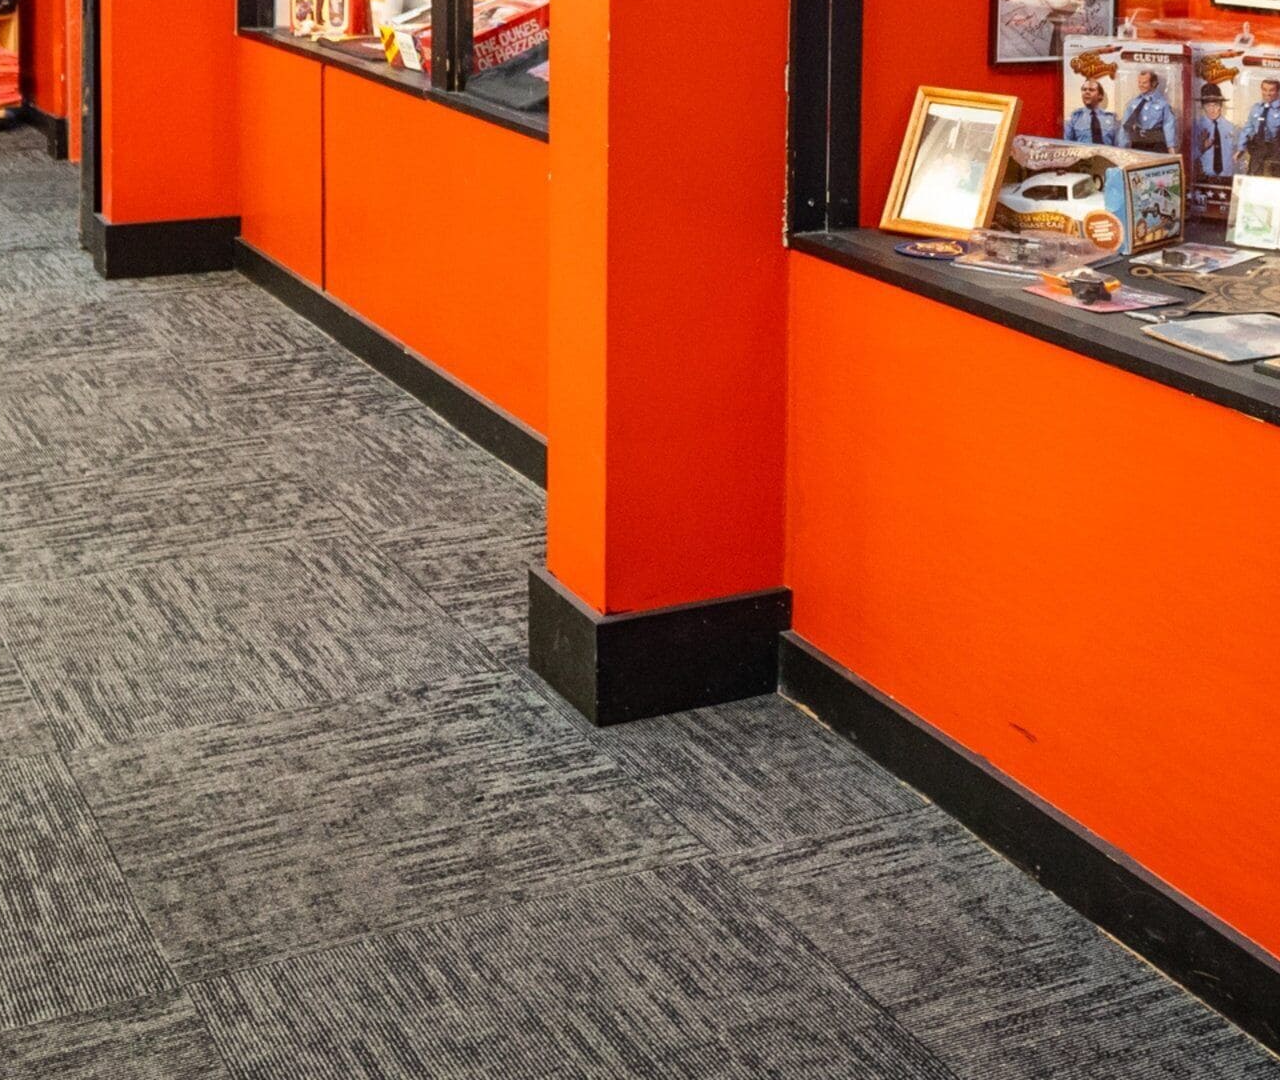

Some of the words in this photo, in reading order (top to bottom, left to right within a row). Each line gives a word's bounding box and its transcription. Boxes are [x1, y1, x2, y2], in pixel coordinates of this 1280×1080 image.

[474, 36, 497, 58] THE
[498, 18, 540, 46] DUKES
[477, 54, 494, 71] OF
[1133, 53, 1170, 63] CLETUS
